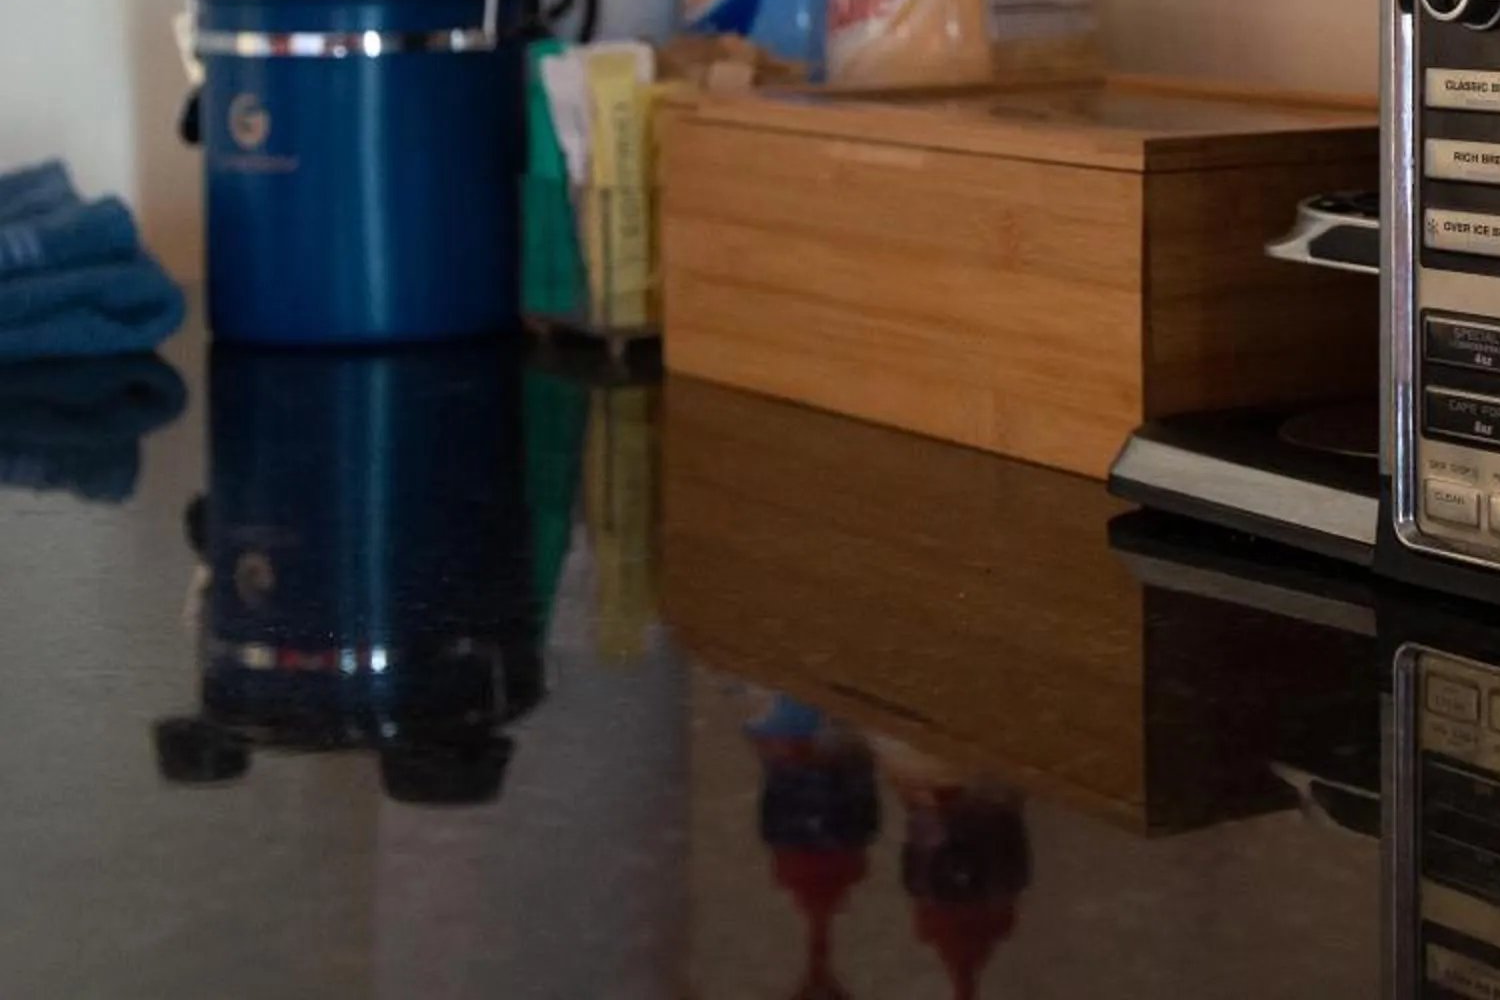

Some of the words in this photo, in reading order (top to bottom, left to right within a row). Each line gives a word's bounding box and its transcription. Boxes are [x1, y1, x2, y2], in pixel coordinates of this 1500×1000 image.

[1445, 80, 1489, 93] CLASSIC
[1453, 151, 1479, 164] RICH
[1443, 221, 1471, 233] OVER
[1473, 223, 1490, 236] ICE
